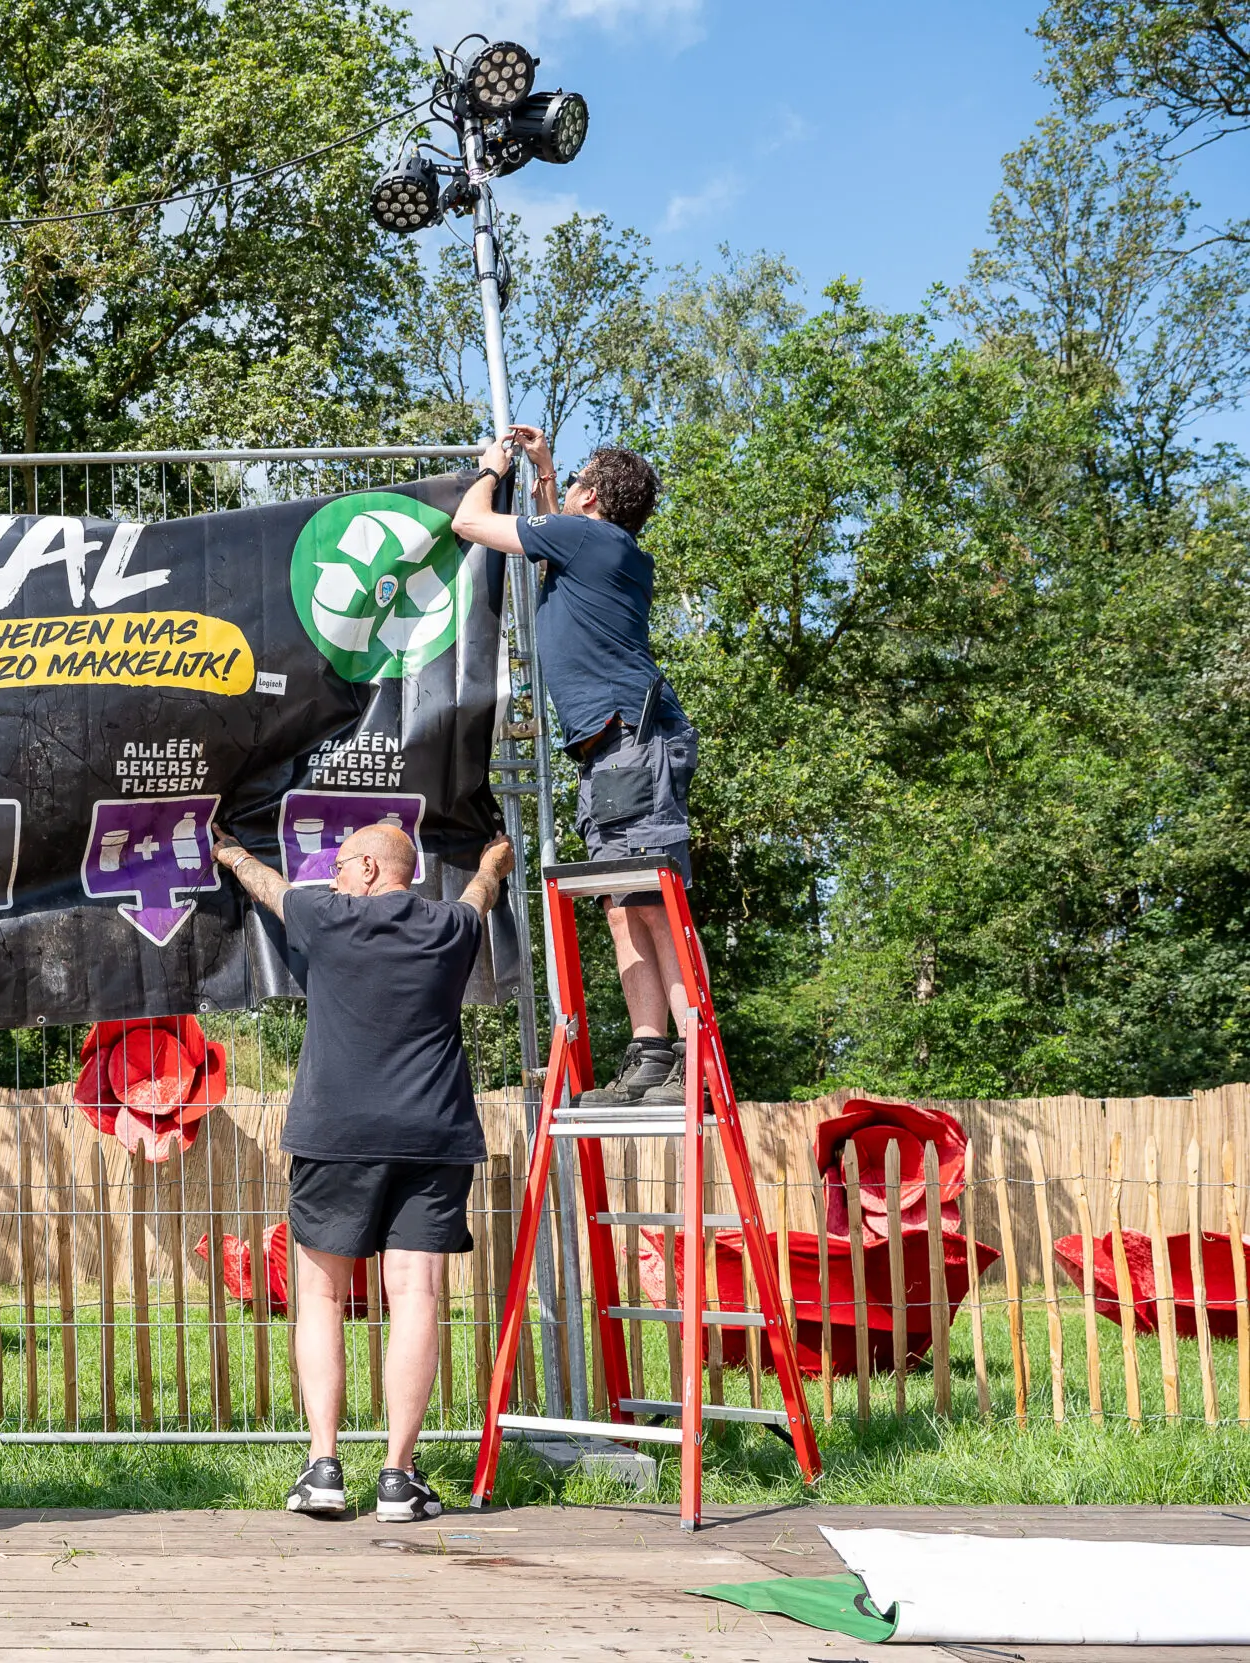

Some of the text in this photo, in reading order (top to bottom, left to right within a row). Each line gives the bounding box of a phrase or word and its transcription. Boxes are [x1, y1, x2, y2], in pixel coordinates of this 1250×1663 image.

[123, 617, 198, 646] WAS
[46, 647, 241, 681] MAKKELIJK!
[258, 678, 283, 689] Logisch
[123, 738, 204, 758] ALLÉÉN
[319, 731, 399, 753] ALLÉÉN
[116, 760, 210, 776] BEKERS &
[307, 753, 406, 770] BEKERS &
[121, 777, 205, 793] FLESSEN
[311, 768, 401, 787] FLESSEN
